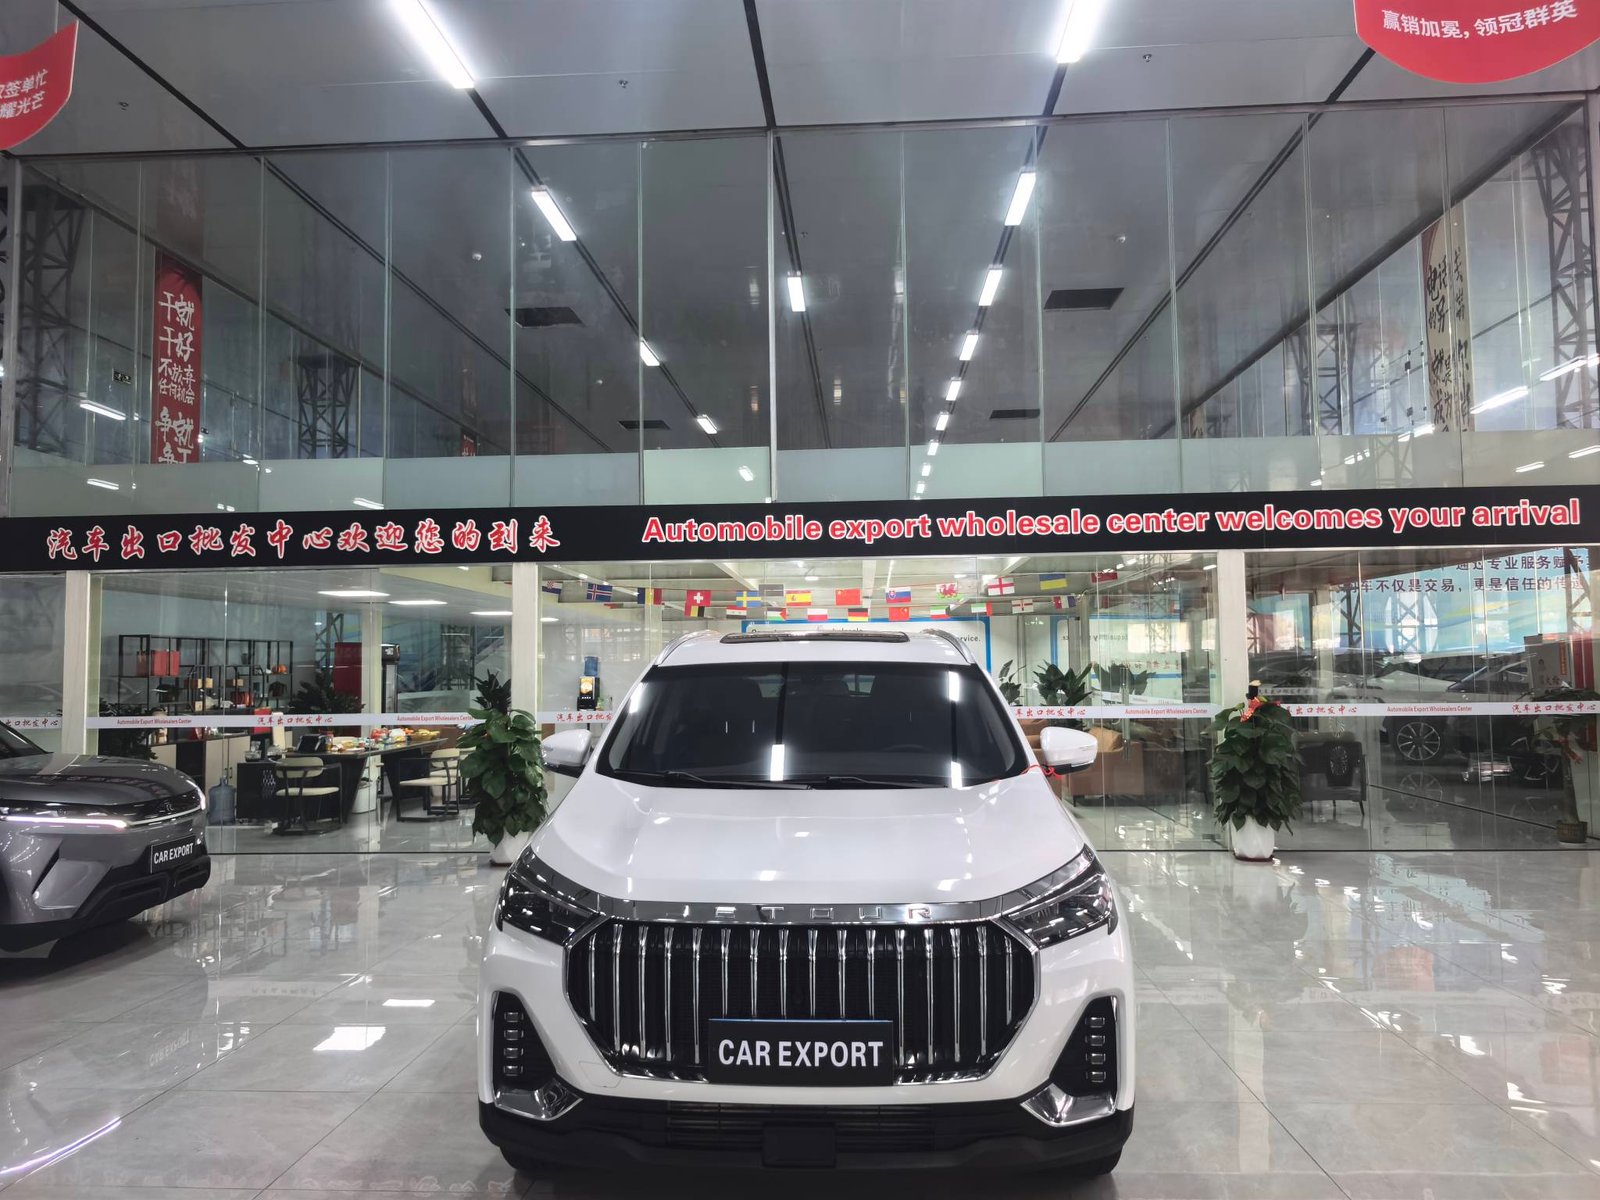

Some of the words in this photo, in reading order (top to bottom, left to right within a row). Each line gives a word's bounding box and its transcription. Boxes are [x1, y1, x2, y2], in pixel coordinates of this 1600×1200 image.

[46, 514, 561, 562] 汽车出口批发中心欢迎您的到来
[642, 514, 822, 543] Automobile
[829, 514, 932, 544] export
[937, 508, 1100, 537] wholesale
[1106, 508, 1210, 533] center
[1215, 503, 1383, 531] welcomes
[1389, 505, 1466, 533] your
[1472, 498, 1581, 527] arrival
[154, 851, 168, 864] CAR
[169, 843, 193, 860] EXPORT
[718, 1039, 771, 1067] CAR
[778, 1040, 884, 1068] EXPORT
